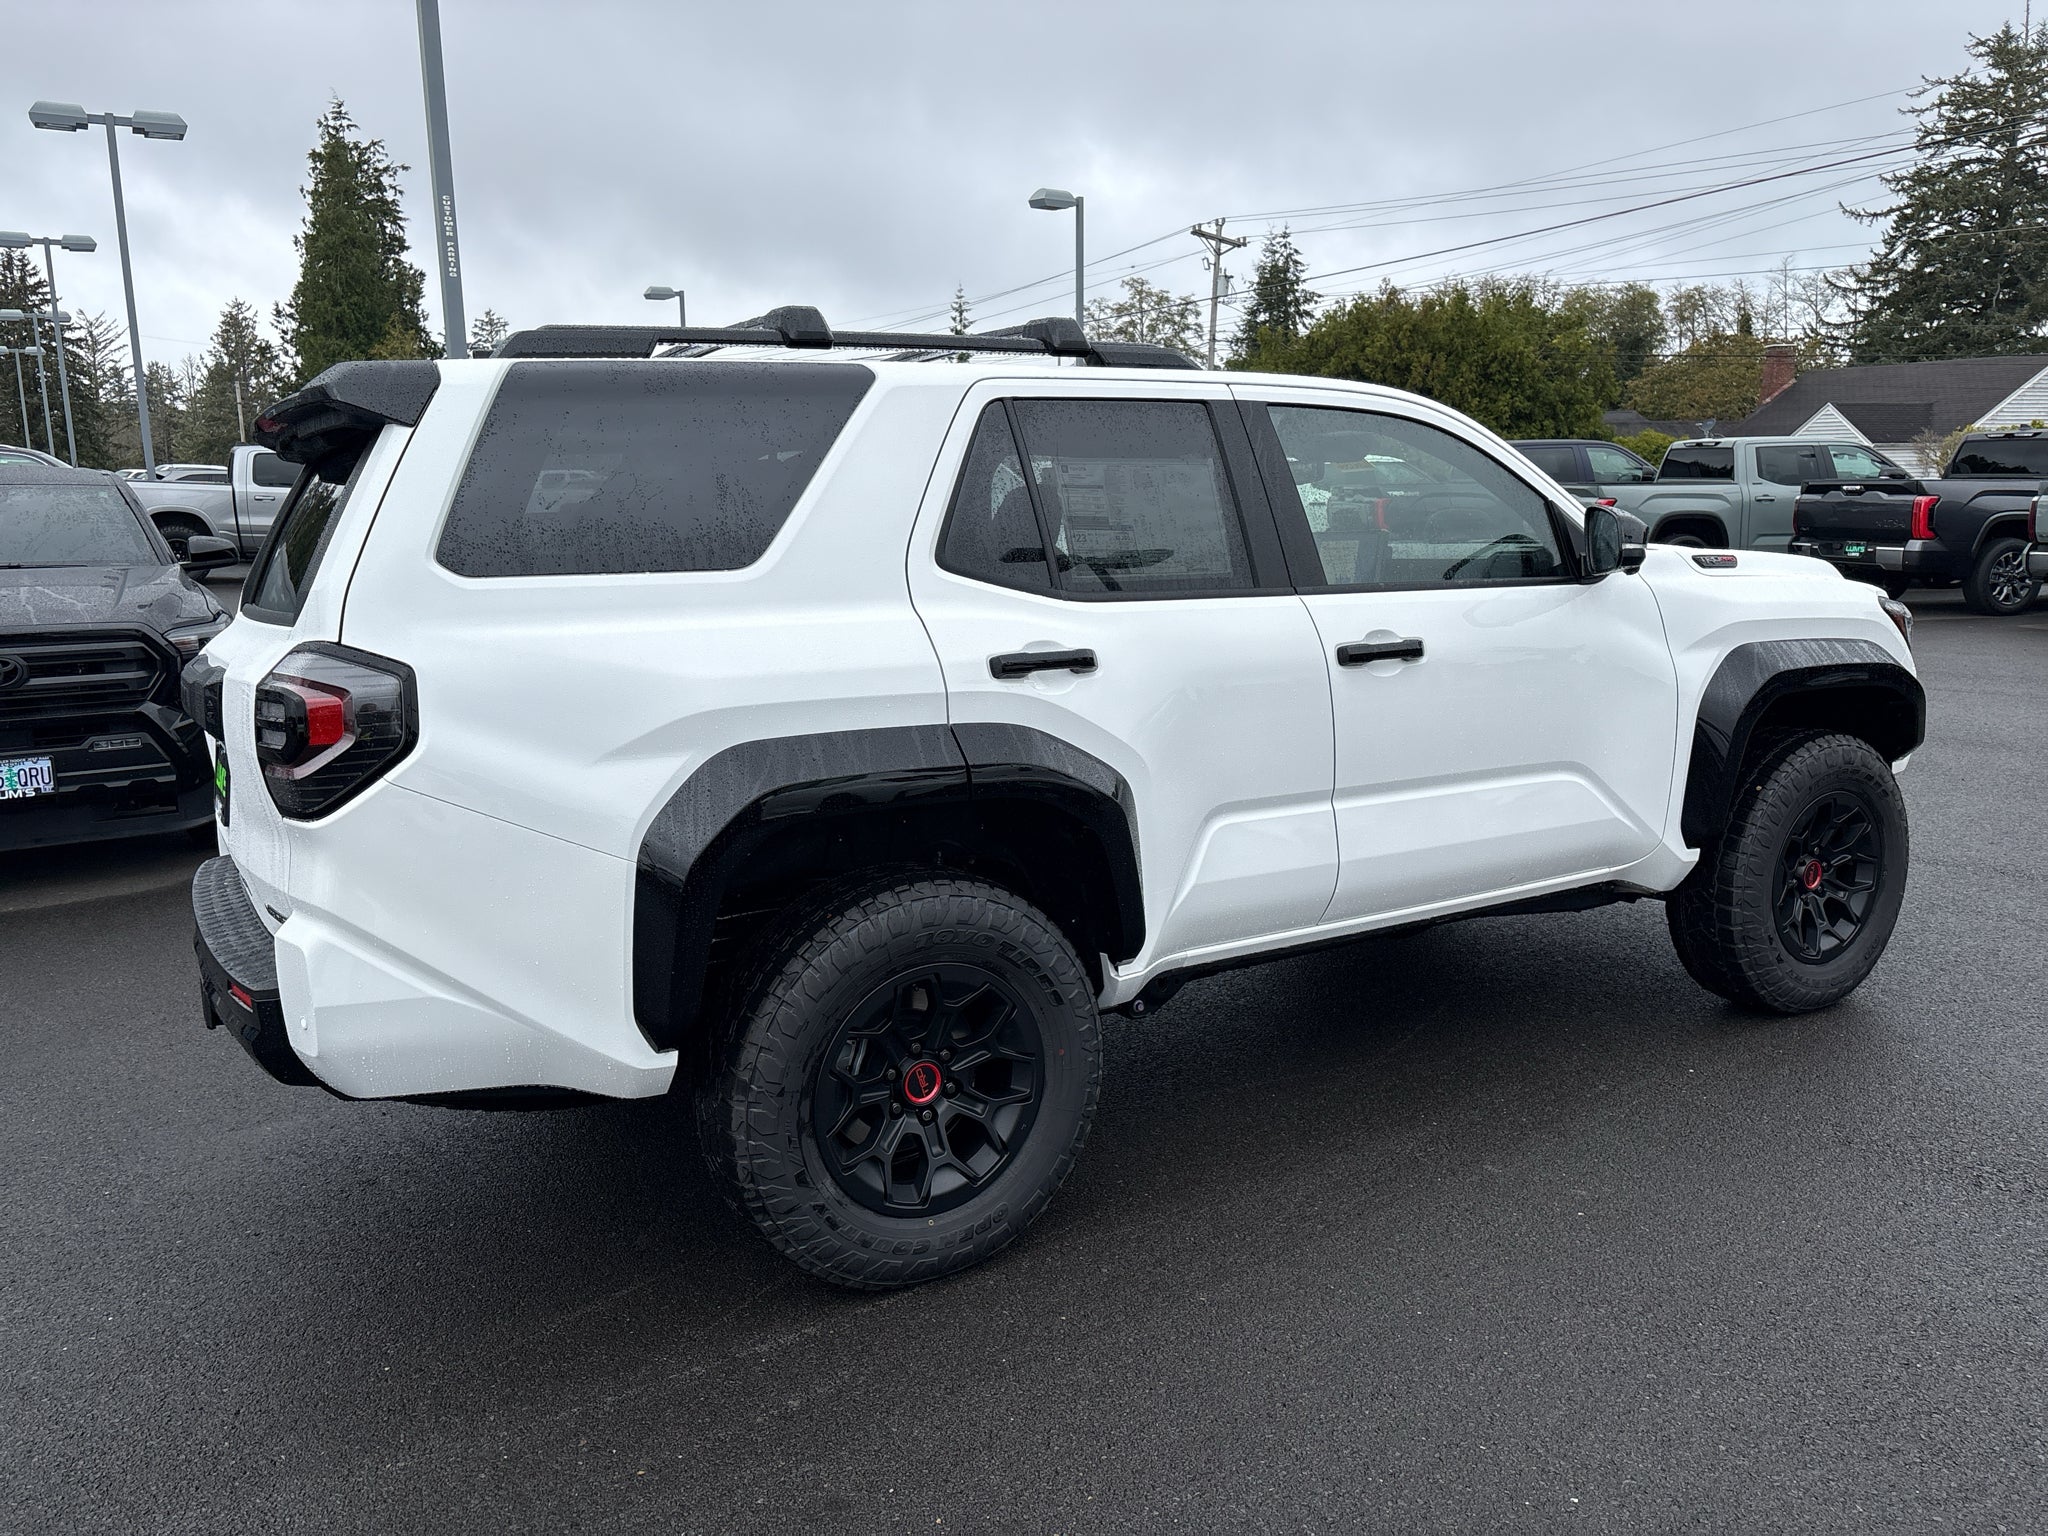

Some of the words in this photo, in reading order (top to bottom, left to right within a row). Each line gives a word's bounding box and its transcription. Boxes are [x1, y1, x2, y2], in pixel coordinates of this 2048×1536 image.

[442, 195, 454, 237] CUSTOMER
[446, 241, 458, 278] PARKING
[17, 765, 52, 788] QRU
[913, 928, 997, 950] TOYO
[915, 1066, 930, 1098] TRD
[938, 1202, 1010, 1251] OPEN
